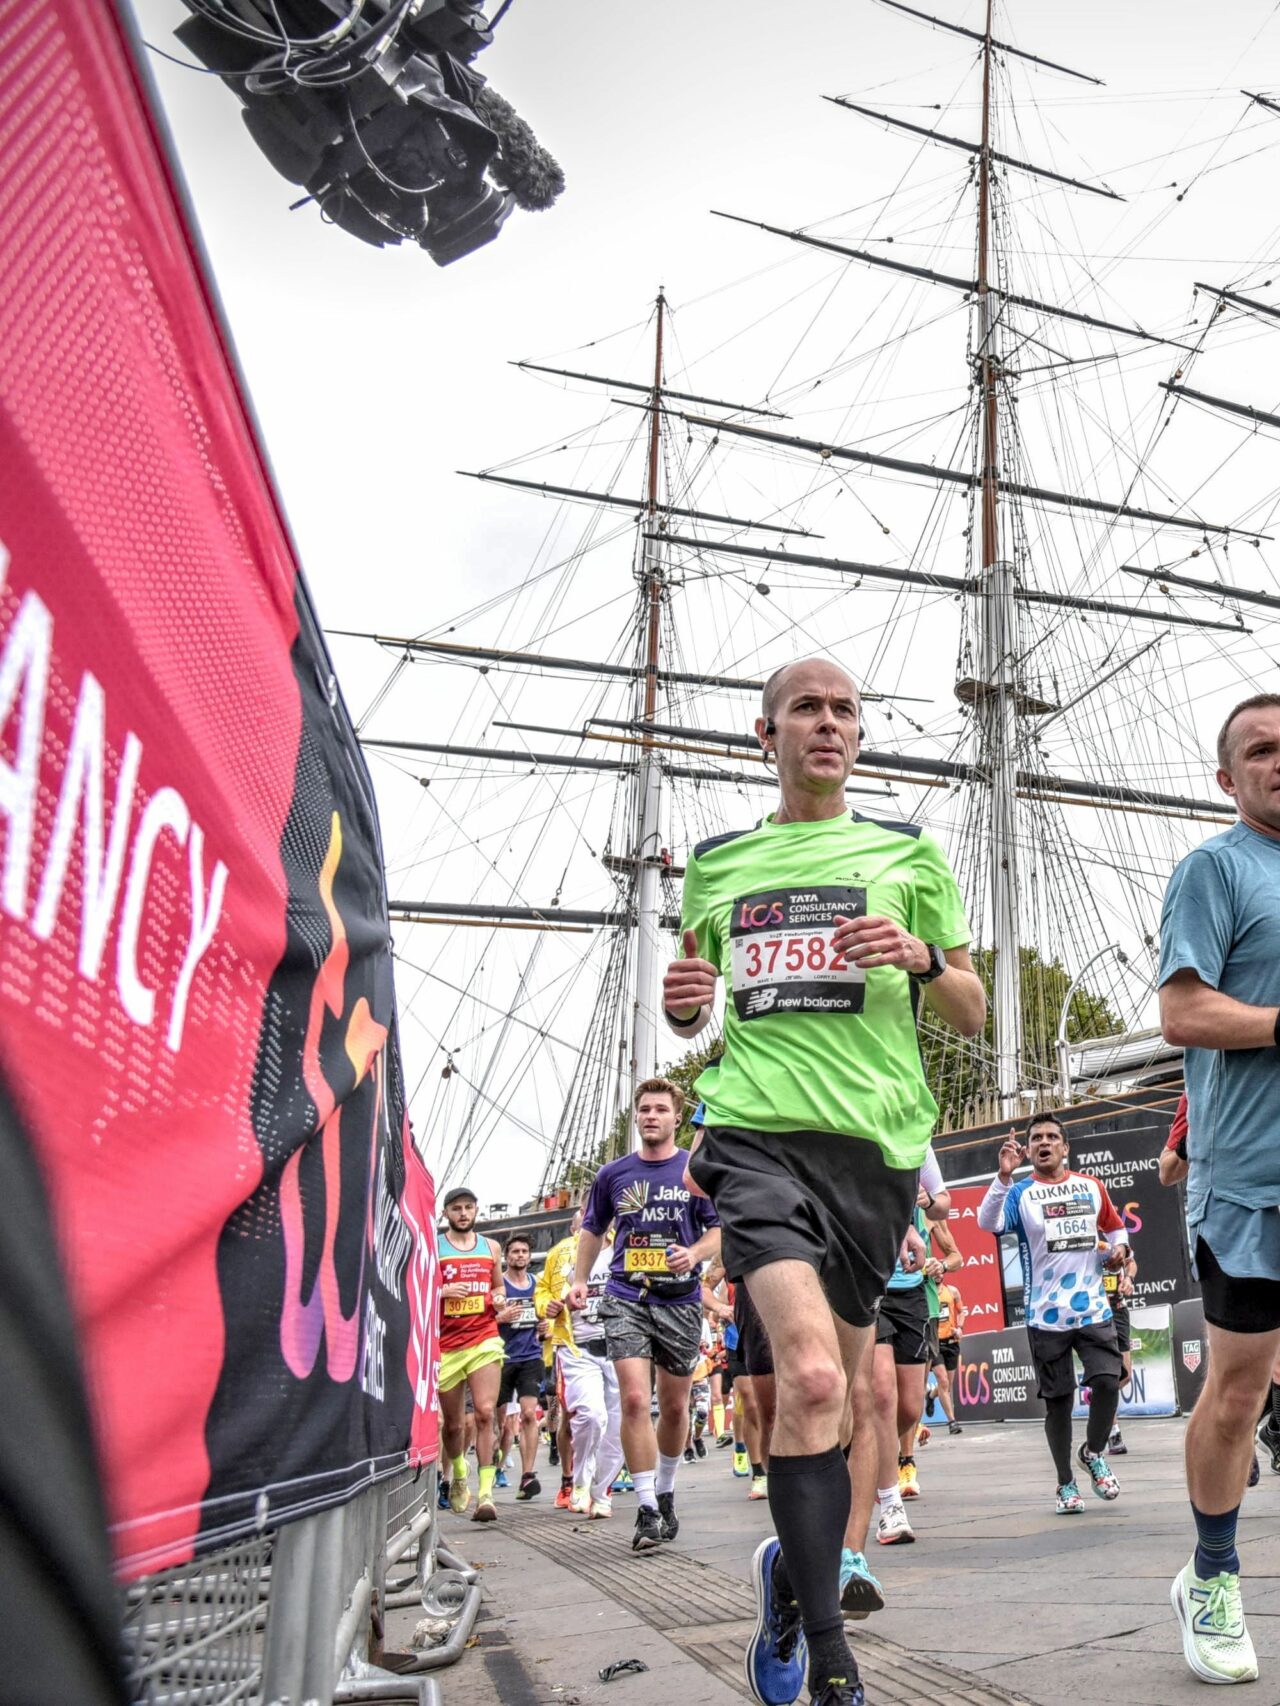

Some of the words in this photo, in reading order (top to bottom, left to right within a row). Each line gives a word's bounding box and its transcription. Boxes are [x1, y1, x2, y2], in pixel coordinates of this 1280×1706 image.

[0, 588, 229, 1052] ANCY
[789, 894, 819, 904] TATA
[740, 901, 784, 929] tcs
[789, 902, 858, 914] CONSULTANCY
[789, 912, 832, 924] SERVICES
[745, 936, 848, 978] 37582
[777, 998, 802, 1008] new
[803, 996, 852, 1009] balance
[1077, 1150, 1114, 1166] TATA
[1100, 1175, 1134, 1190] VICES
[654, 1185, 691, 1203] Jake
[1028, 1183, 1089, 1201] LUKMAN
[641, 1206, 685, 1222] MS-UK
[1045, 1205, 1065, 1217] tcs
[1055, 1218, 1087, 1236] 1664
[629, 1234, 649, 1247] tcs
[631, 1251, 670, 1267] 3337
[1020, 1241, 1031, 1295] WaterAid
[1132, 1279, 1177, 1296] LTANCY
[449, 1299, 480, 1312] 30795
[961, 1303, 999, 1317] SAN
[992, 1347, 1015, 1364] TATA
[1184, 1343, 1199, 1353] TAG
[957, 1354, 990, 1406] tcs
[992, 1365, 1036, 1384] CONSULTAN
[993, 1386, 1027, 1403] SERVICES
